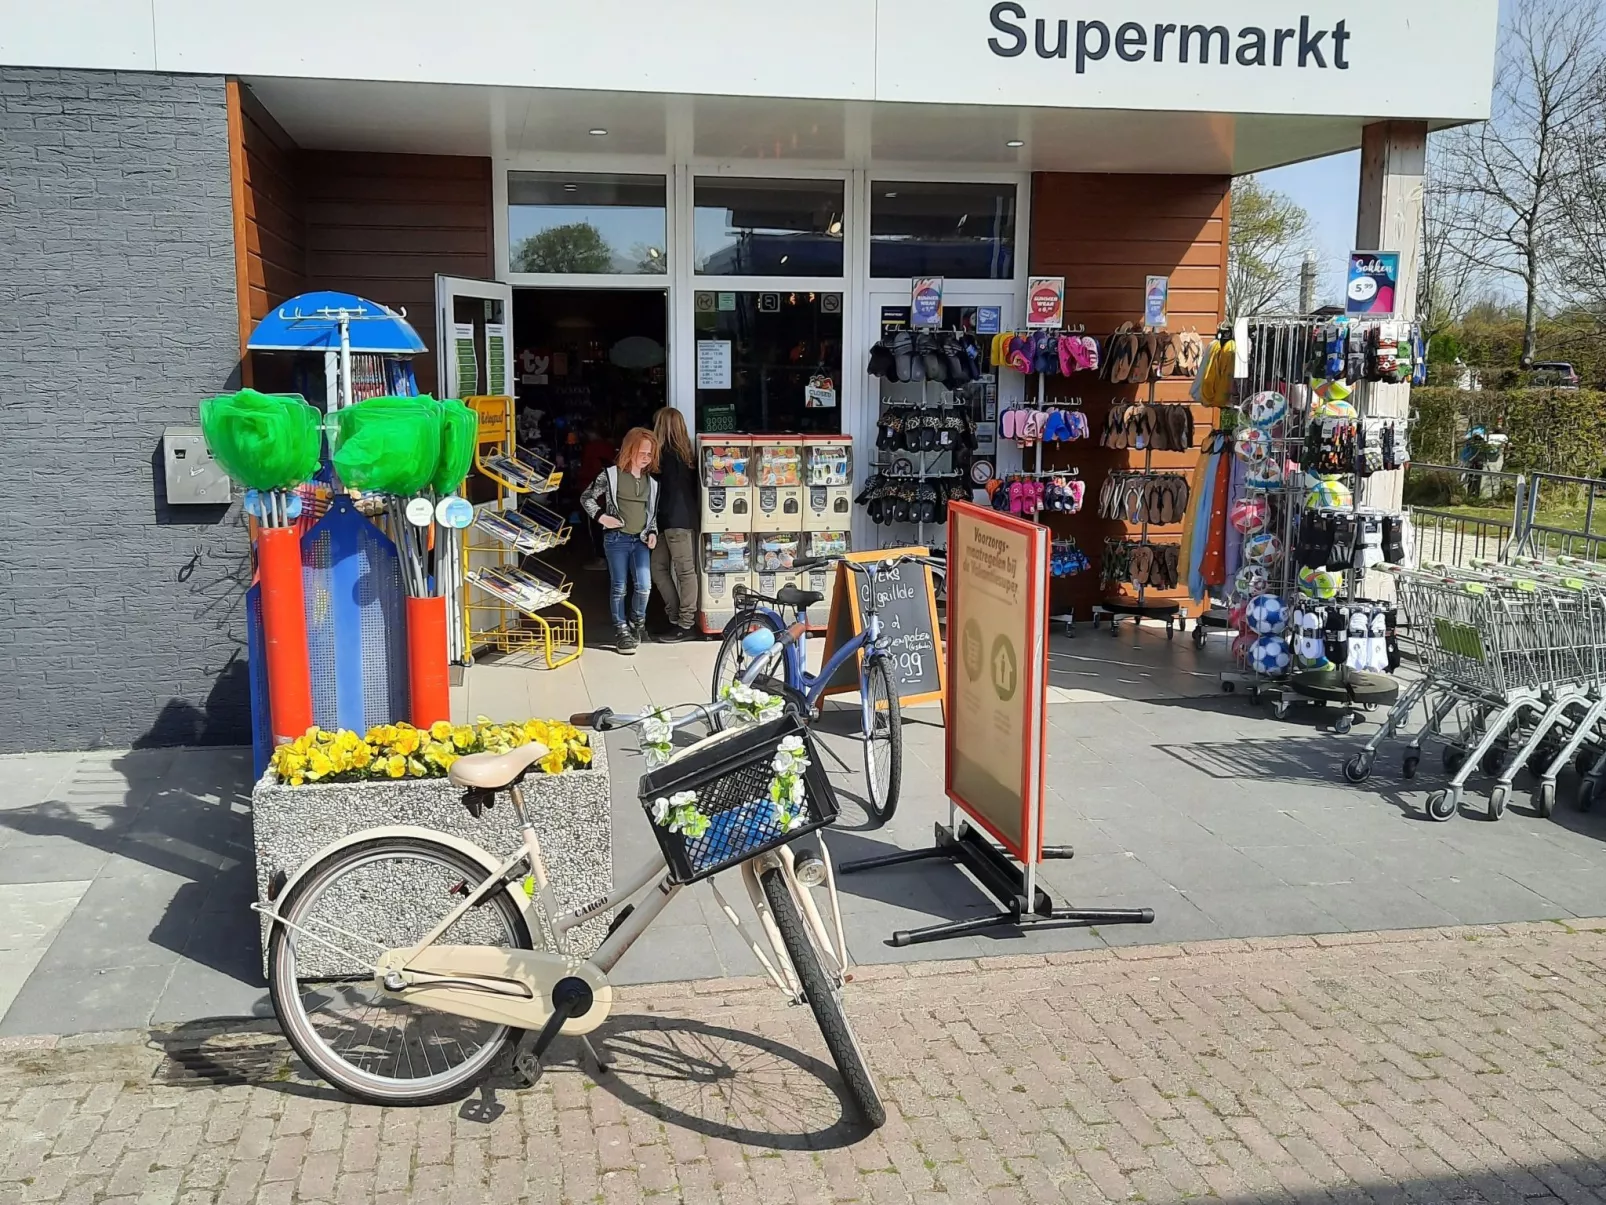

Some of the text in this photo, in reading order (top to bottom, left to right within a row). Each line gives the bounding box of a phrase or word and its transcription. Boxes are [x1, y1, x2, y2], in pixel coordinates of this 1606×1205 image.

[987, 1, 1350, 74] Supermarkt
[1355, 259, 1393, 273] Sokken
[519, 350, 549, 374] ty
[808, 389, 832, 398] CLOSED
[974, 526, 1009, 554] Voorzorgs-
[1007, 557, 1018, 578] bij
[574, 897, 608, 918] CARGO
